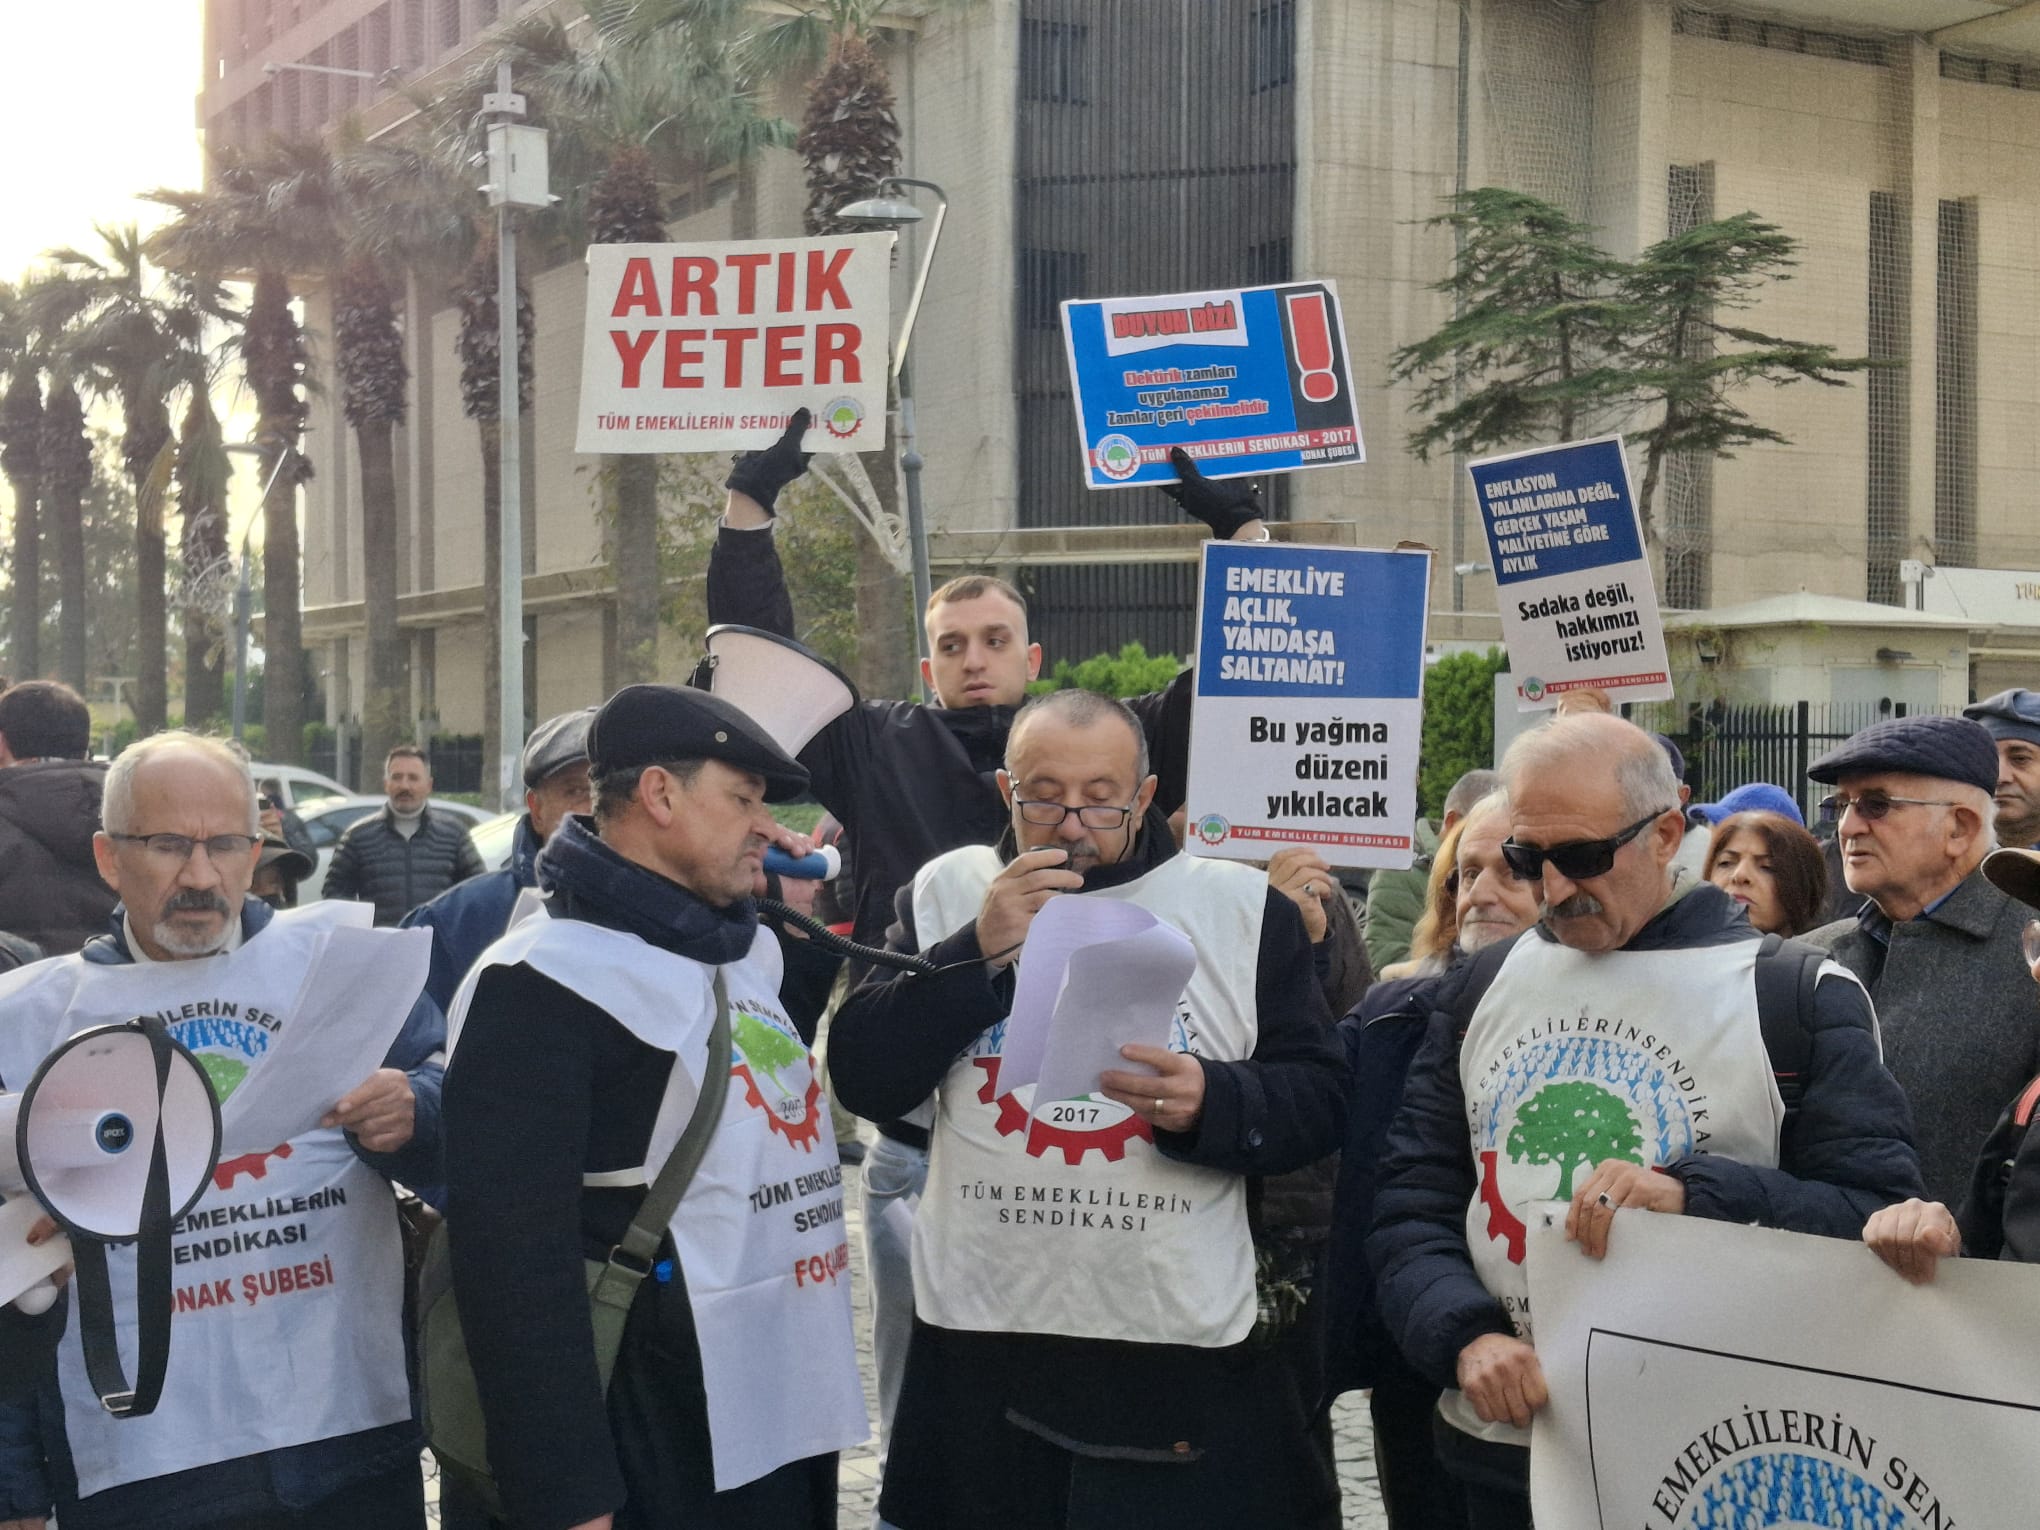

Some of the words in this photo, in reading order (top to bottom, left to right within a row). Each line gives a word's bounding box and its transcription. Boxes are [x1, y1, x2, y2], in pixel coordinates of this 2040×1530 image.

[611, 248, 855, 317] ARTIK
[1112, 309, 1190, 338] DUYUN
[1190, 300, 1237, 332] BİZİ
[610, 323, 862, 388] YETER
[1124, 368, 1183, 387] Elektirik
[1185, 365, 1237, 382] zamları
[1138, 386, 1228, 407] uygulanamaz
[597, 411, 629, 431] TÜM
[635, 411, 734, 431] EMEKLİLERİN
[1107, 409, 1155, 427] Zamlar
[1156, 407, 1185, 427] geri
[1186, 399, 1269, 425] çekilmelidir
[1249, 433, 1310, 453] SENDİKASI
[1322, 428, 1352, 444] 2017
[1485, 472, 1557, 499] ENFLASYON
[1488, 489, 1577, 517] YALANLARINA
[1578, 481, 1620, 504] DEĞİL,
[1494, 515, 1543, 537] GERÇEK
[1543, 507, 1588, 530] YAŞAM
[1497, 530, 1571, 555] MALİYETİNE
[1573, 524, 1609, 544] GÖRE
[1502, 554, 1539, 574] AYLIK
[1226, 565, 1345, 597] EMEKLİYE
[1223, 596, 1298, 627] AÇLIK,
[1518, 594, 1580, 621] Sadaka
[1584, 582, 1634, 609] değil,
[1556, 610, 1640, 639] hakkımızı
[1223, 626, 1335, 660] YANDAŞA
[1565, 630, 1645, 662] istiyoruz!
[1220, 656, 1345, 686] SALTANAT!
[1250, 716, 1286, 744] Bu
[1295, 716, 1388, 746] yağma
[1295, 753, 1388, 781] düzeni
[1267, 790, 1388, 820] yıkılacak
[1052, 1106, 1100, 1124] 2017
[749, 1183, 793, 1213] TÜM
[960, 1181, 1003, 1201] TÜM
[1014, 1185, 1192, 1214] EMEKLİLERİN
[999, 1207, 1146, 1231] SENDİKASI
[174, 1223, 308, 1265] ENDİKASI
[242, 1254, 335, 1306] ŞUBESİ
[1652, 1403, 1877, 1524] EMEKLİLERİN
